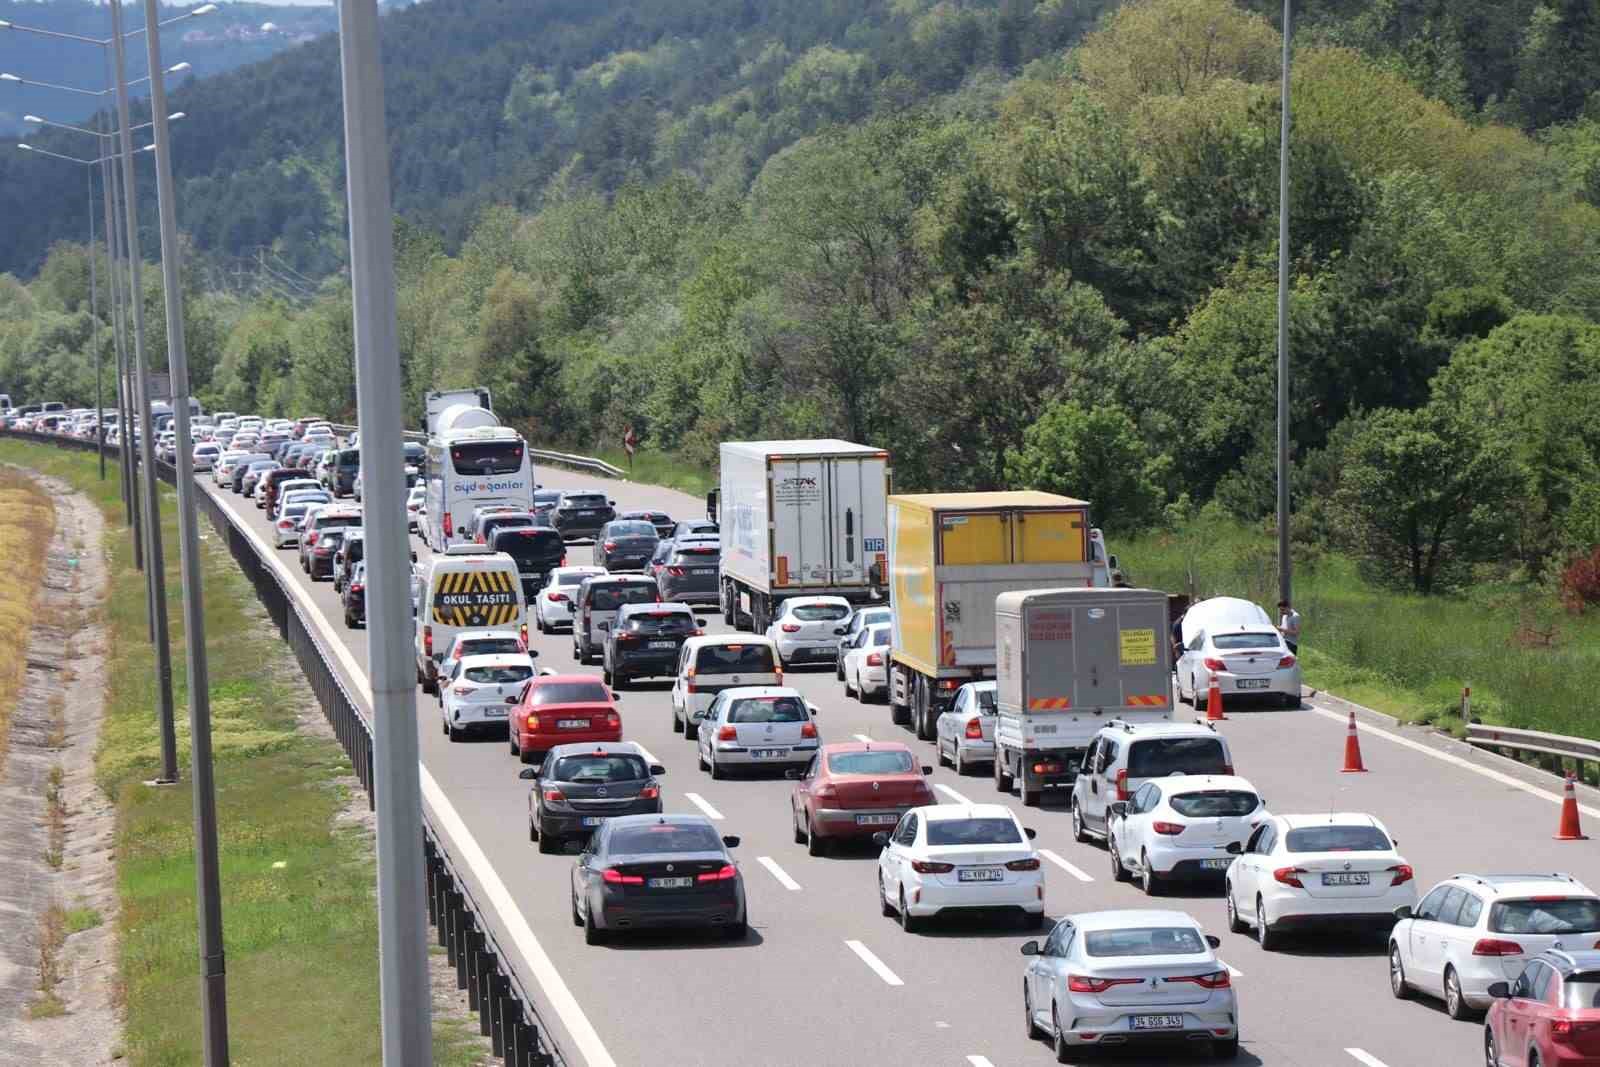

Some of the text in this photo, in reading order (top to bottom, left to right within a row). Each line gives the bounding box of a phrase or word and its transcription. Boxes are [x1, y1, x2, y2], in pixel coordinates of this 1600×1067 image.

[865, 539, 884, 551] TIR
[443, 593, 510, 605] OKUL TAŞITI
